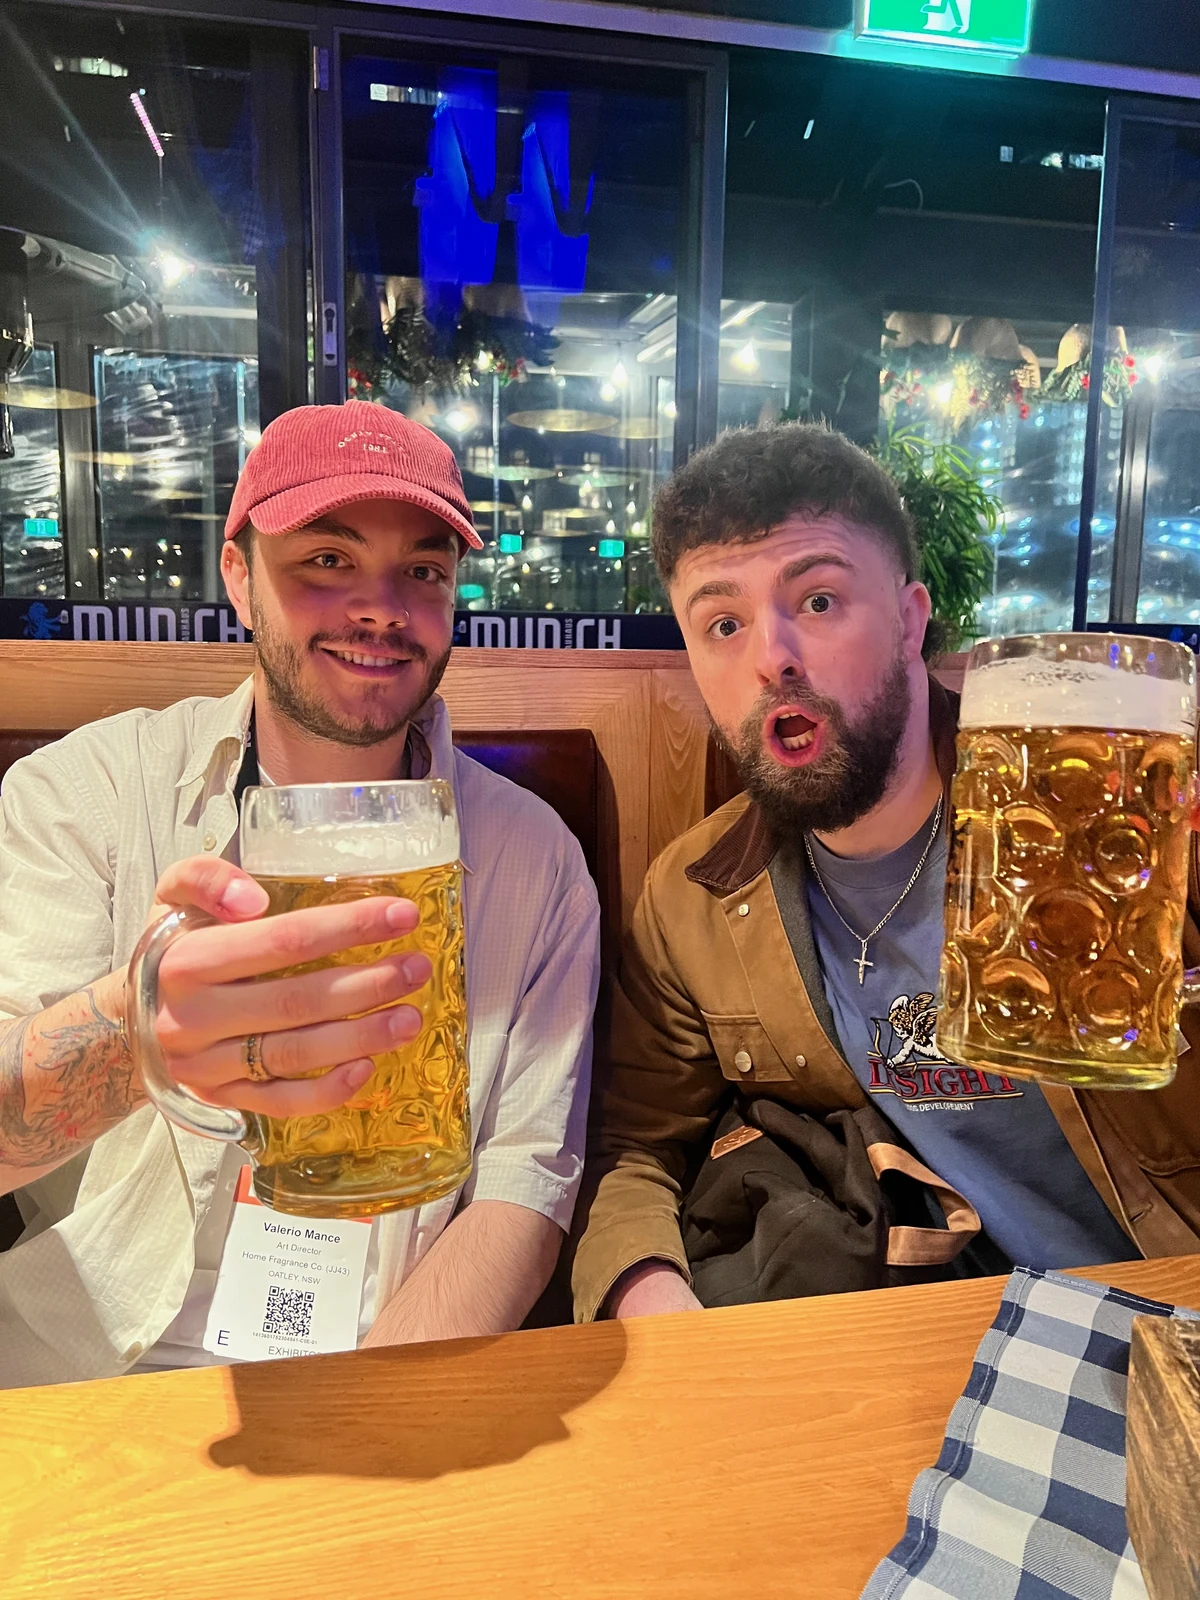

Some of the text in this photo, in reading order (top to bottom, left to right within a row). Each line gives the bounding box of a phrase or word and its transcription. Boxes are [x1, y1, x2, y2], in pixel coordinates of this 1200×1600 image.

[263, 1222, 341, 1244] Valerio Mance
[276, 1241, 322, 1256] Art Director
[242, 1251, 267, 1262] Home
[268, 1255, 309, 1268] Fragrance
[325, 1265, 350, 1277] (JJ43)
[301, 1275, 321, 1285] NSW
[217, 1329, 230, 1346] E
[268, 1345, 322, 1357] EXHIBIT
